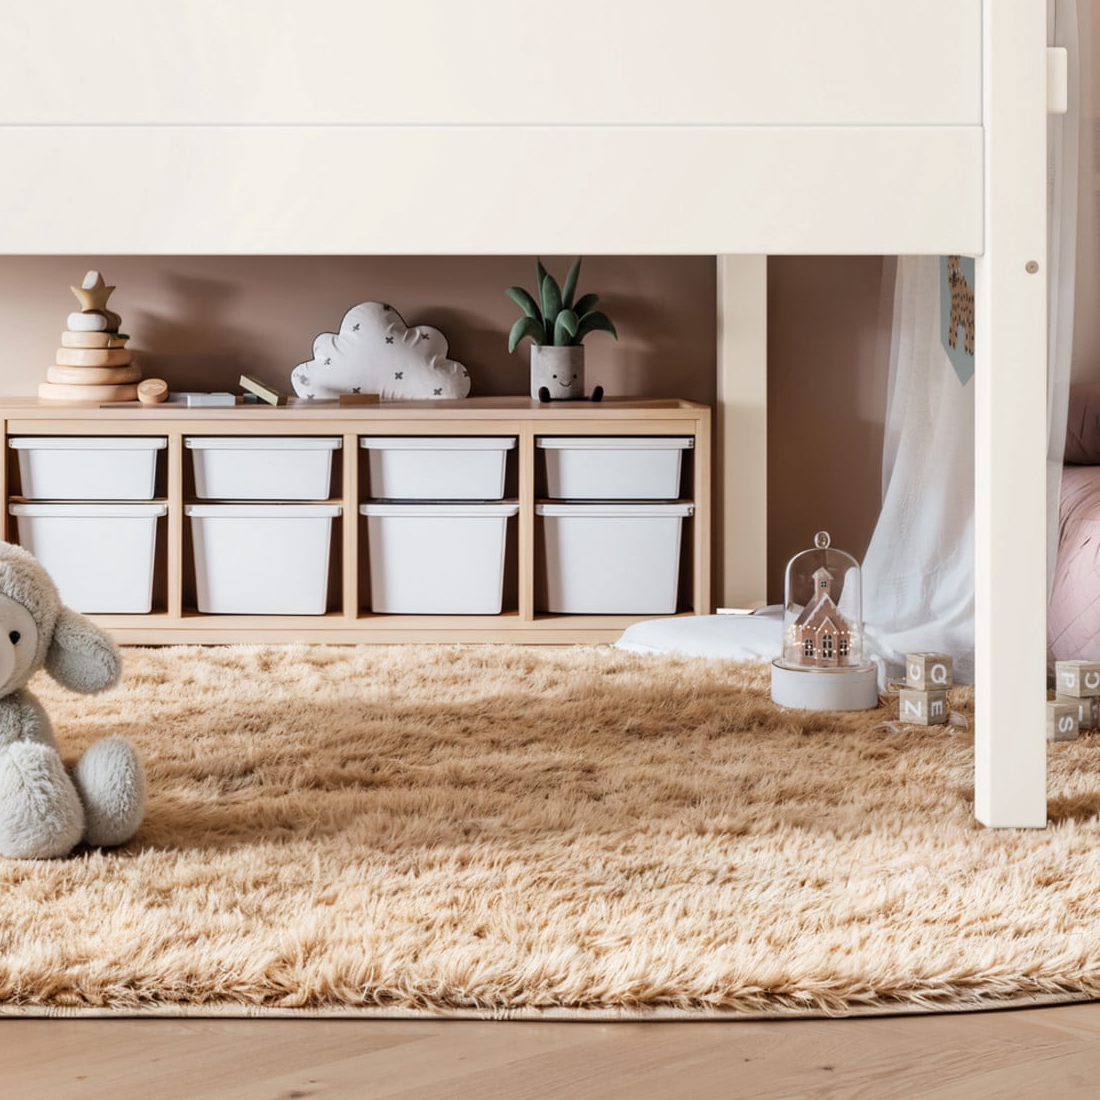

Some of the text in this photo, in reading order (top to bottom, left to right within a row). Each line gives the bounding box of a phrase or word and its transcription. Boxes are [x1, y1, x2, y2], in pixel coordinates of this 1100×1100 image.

[930, 663, 947, 685] Q
[1060, 672, 1075, 688] P
[931, 700, 943, 717] E
[1058, 716, 1074, 733] S
